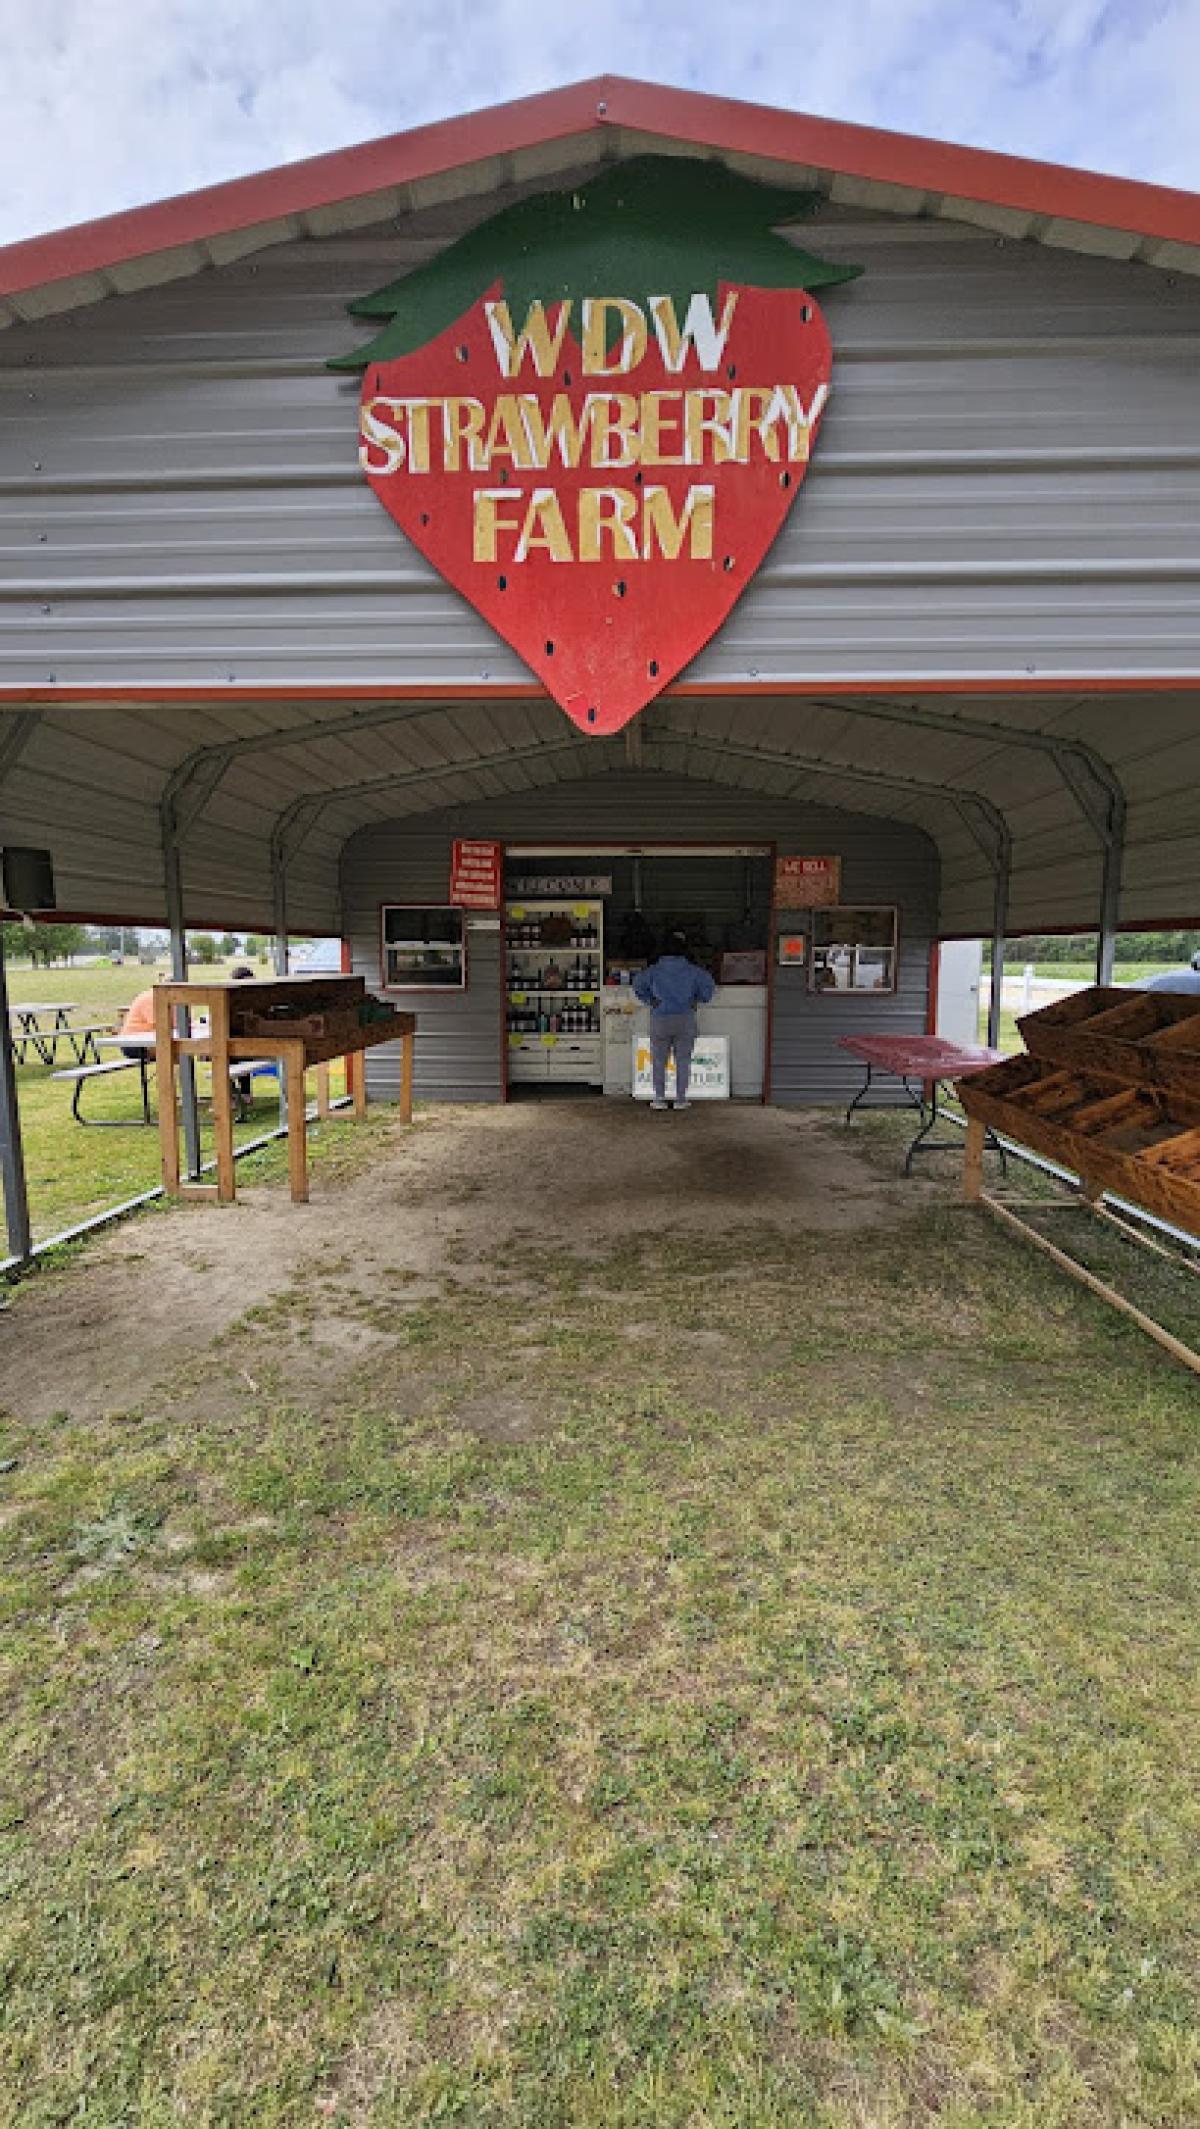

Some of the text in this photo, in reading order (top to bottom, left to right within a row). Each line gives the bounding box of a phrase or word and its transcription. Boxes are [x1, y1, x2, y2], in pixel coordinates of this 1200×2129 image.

[484, 293, 739, 377] WDW
[359, 384, 827, 474] STRAWBERRY
[473, 485, 715, 563] FARM
